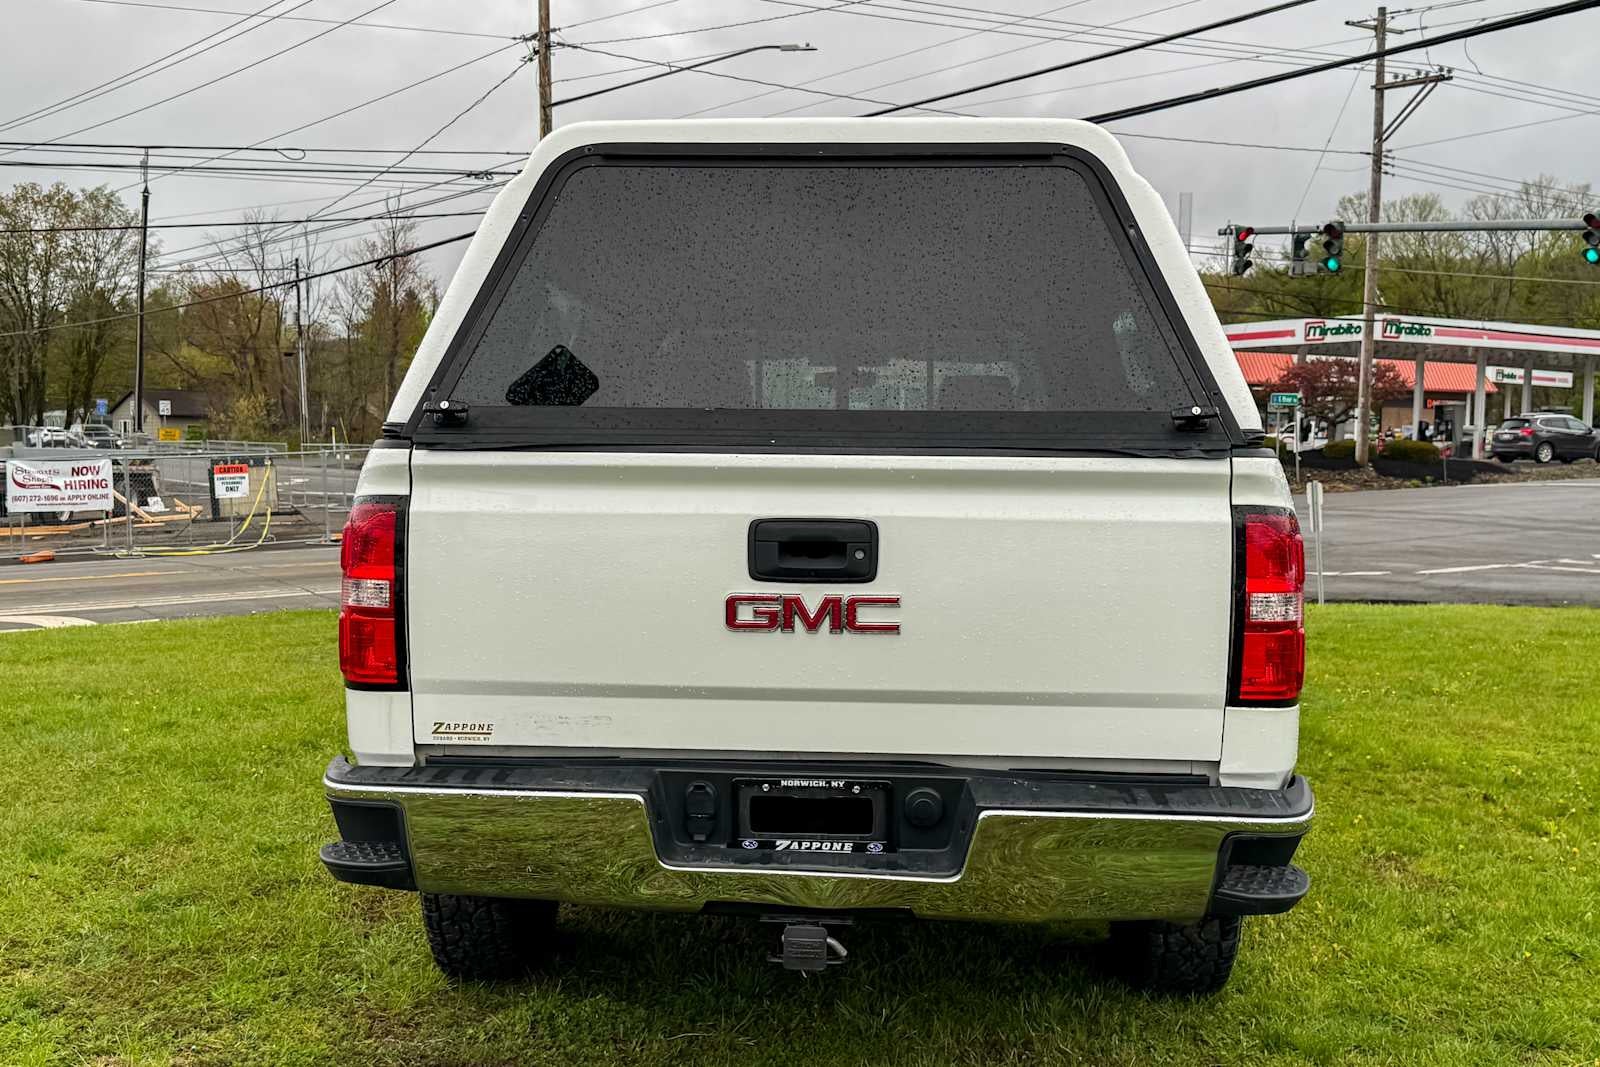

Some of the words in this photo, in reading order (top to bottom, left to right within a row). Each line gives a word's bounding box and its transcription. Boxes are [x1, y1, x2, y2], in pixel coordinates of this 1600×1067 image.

[1306, 322, 1362, 337] Mirabito
[1383, 319, 1432, 337] Mirabito
[71, 465, 100, 477] NOW
[64, 478, 108, 490] HIRING
[725, 593, 901, 635] GMC
[431, 722, 494, 734] ZAPPONE
[780, 780, 829, 788] NORWICH,
[831, 780, 845, 788] NY
[775, 840, 854, 851] ZAPPONE
